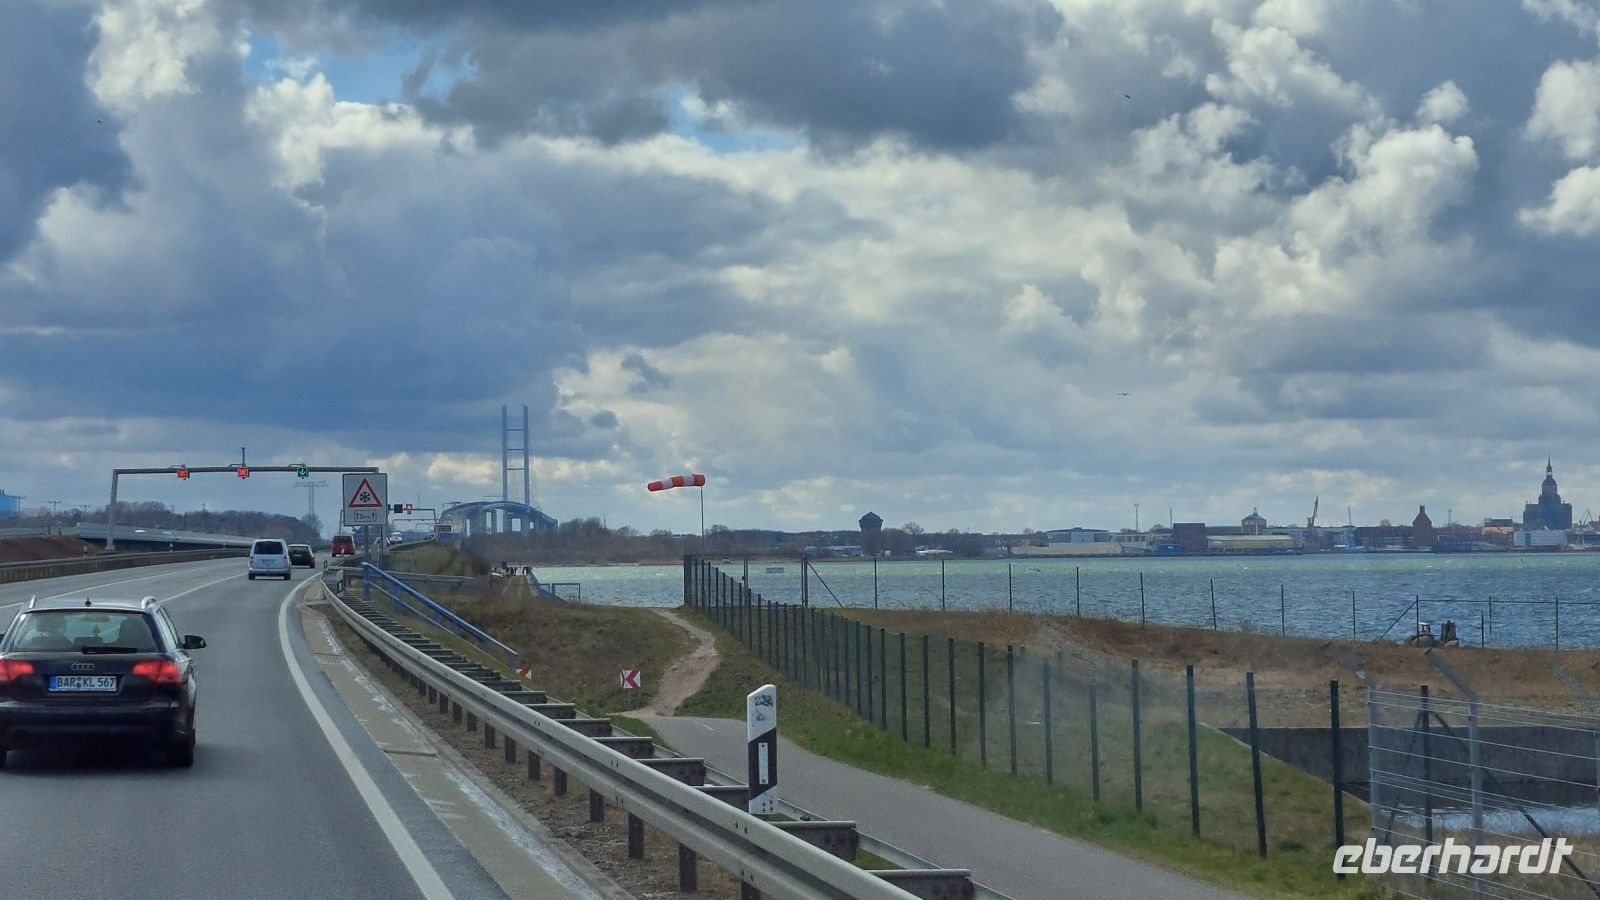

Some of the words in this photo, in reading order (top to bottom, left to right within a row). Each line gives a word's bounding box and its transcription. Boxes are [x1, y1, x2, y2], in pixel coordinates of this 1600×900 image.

[57, 677, 76, 687] BAR
[83, 677, 95, 687] KL
[98, 677, 115, 687] 567
